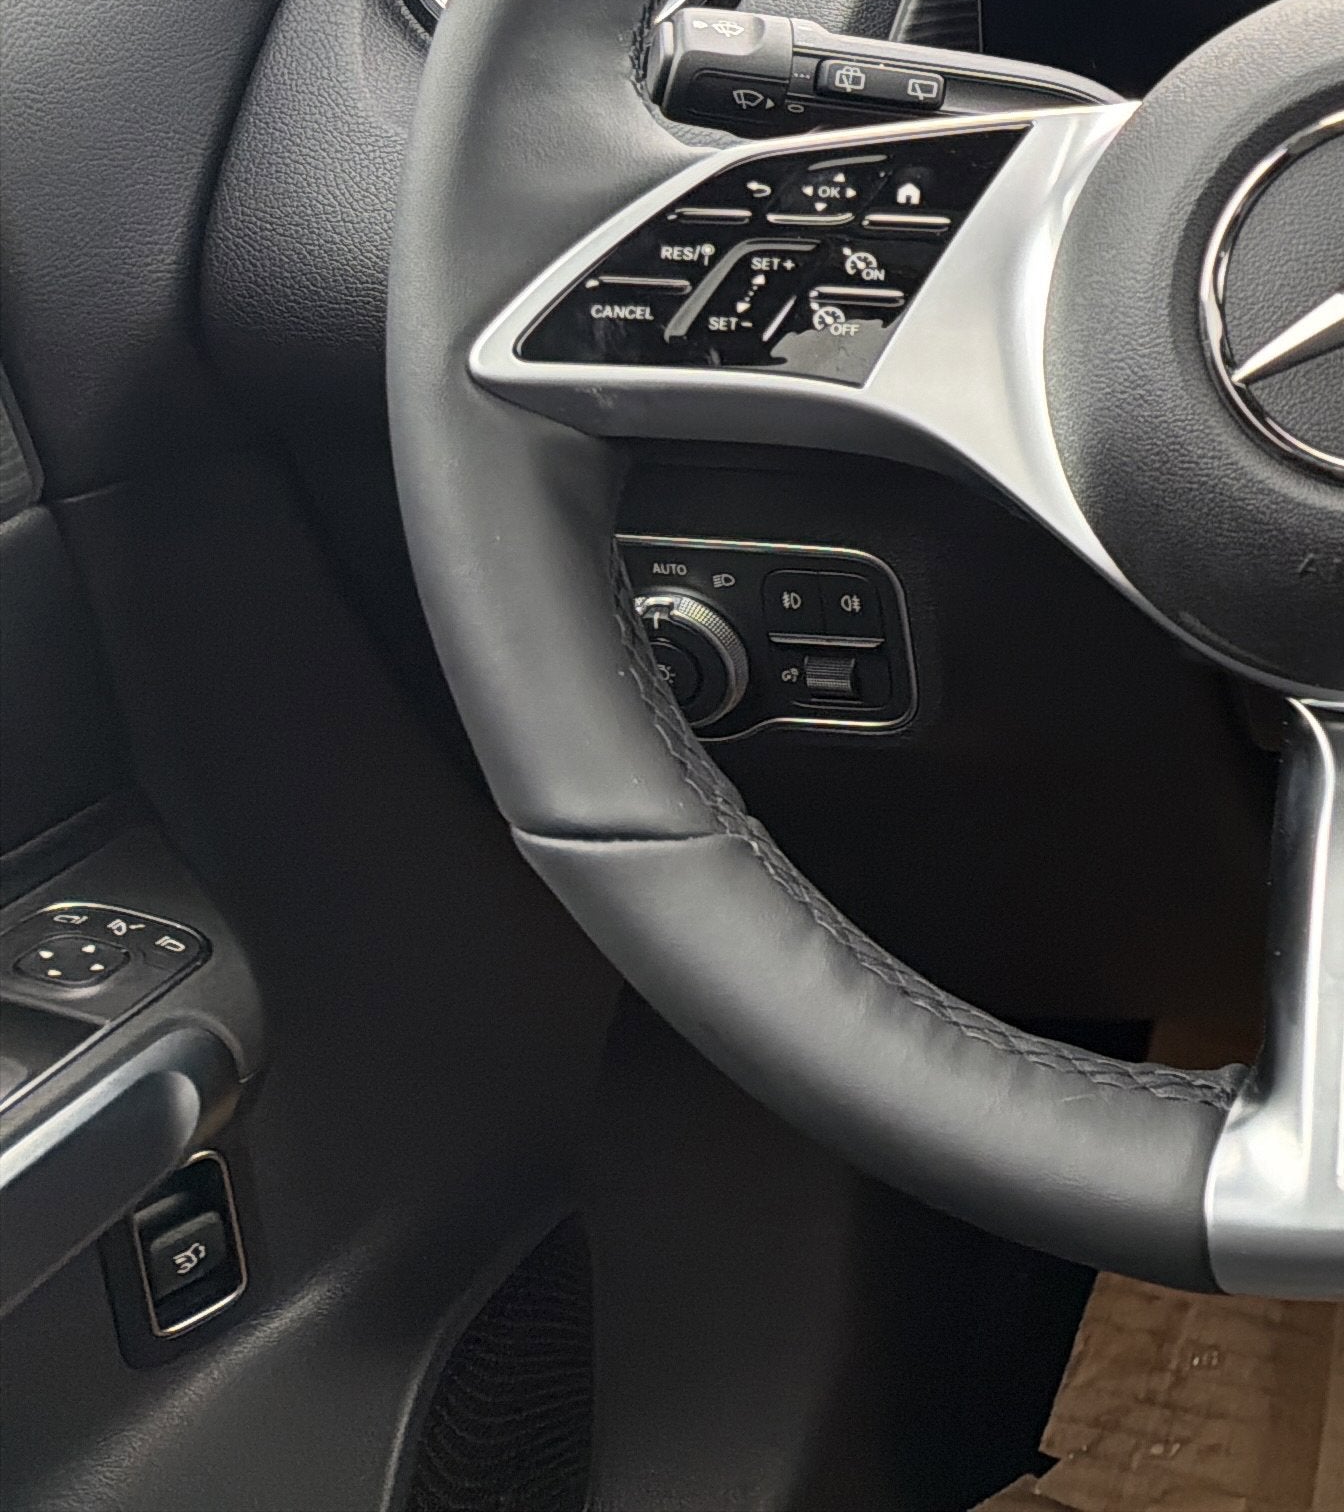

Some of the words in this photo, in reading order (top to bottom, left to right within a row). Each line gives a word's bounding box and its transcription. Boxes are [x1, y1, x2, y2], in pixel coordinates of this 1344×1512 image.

[818, 186, 841, 200] OK
[861, 268, 886, 281] ON
[590, 305, 654, 321] CANCEL
[830, 323, 860, 337] OFF
[652, 562, 687, 577] AUTO
